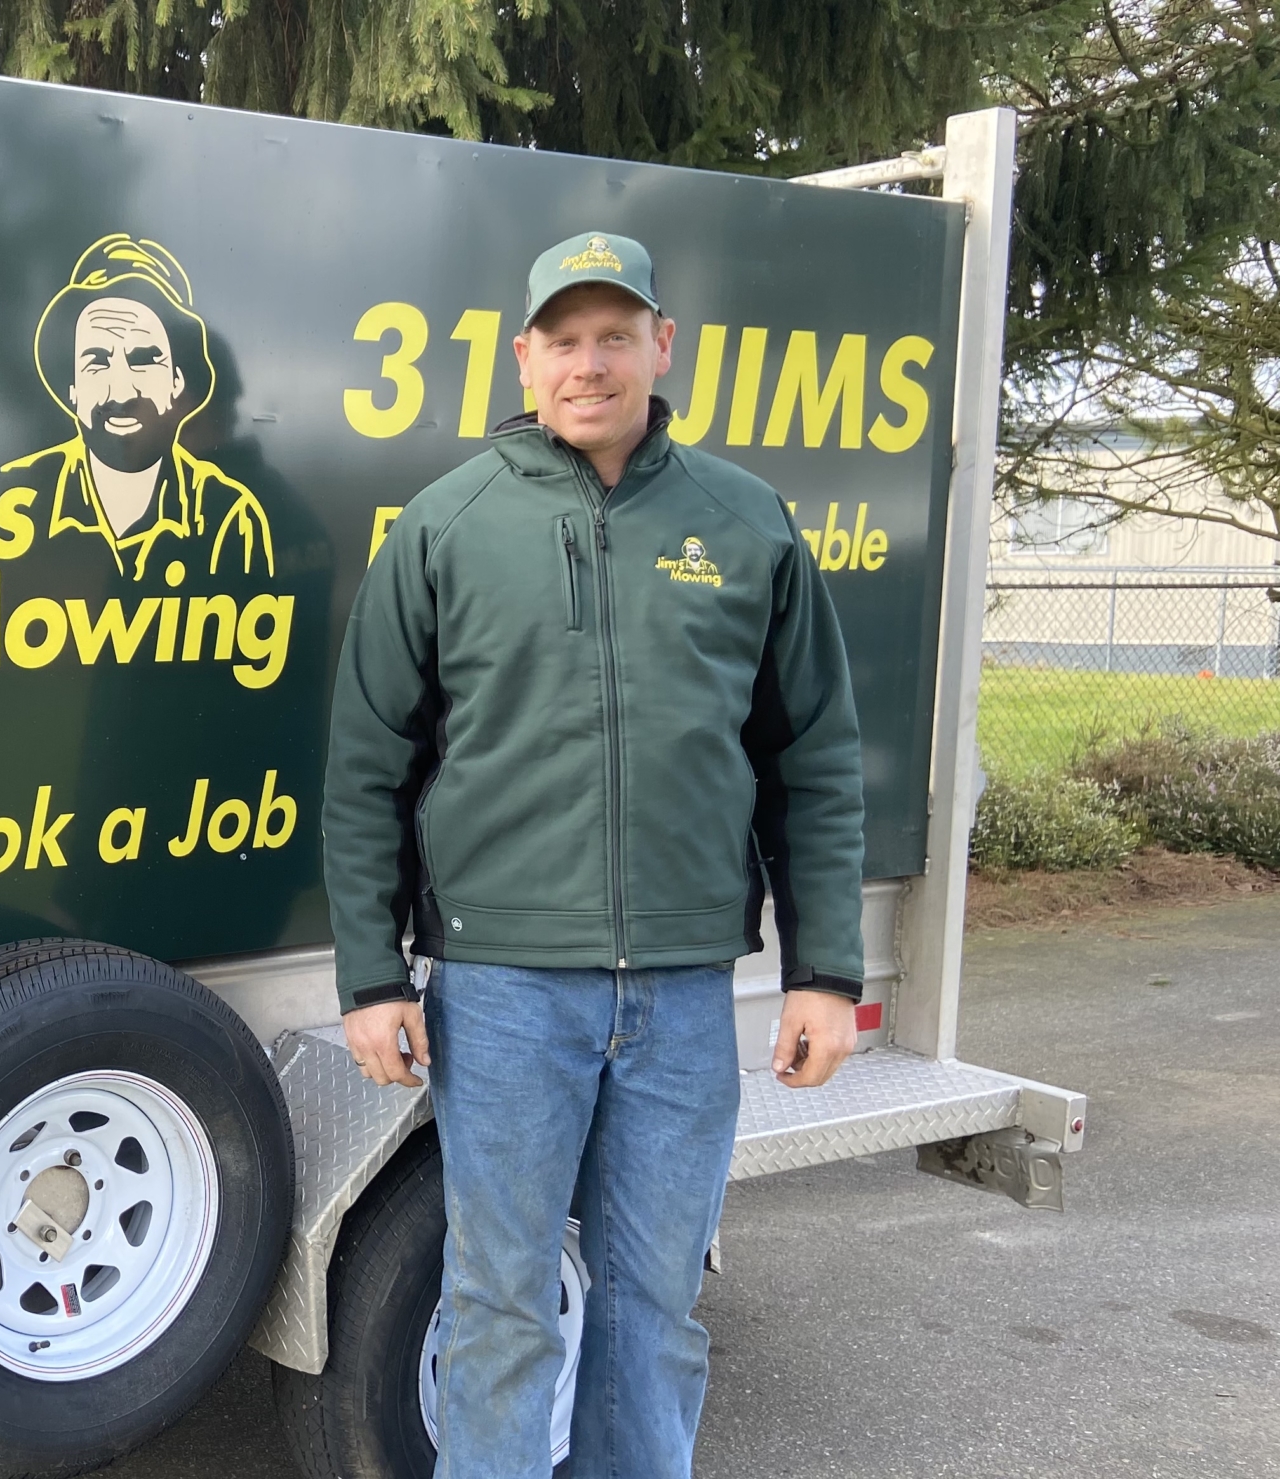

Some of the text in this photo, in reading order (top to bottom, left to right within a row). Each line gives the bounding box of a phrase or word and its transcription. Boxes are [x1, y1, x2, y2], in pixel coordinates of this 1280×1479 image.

[559, 252, 587, 270] Jim's
[571, 256, 623, 273] Mowing
[655, 556, 685, 570] Jim's
[670, 569, 722, 588] Mowing
[98, 807, 147, 864] a
[167, 769, 297, 858] Job
